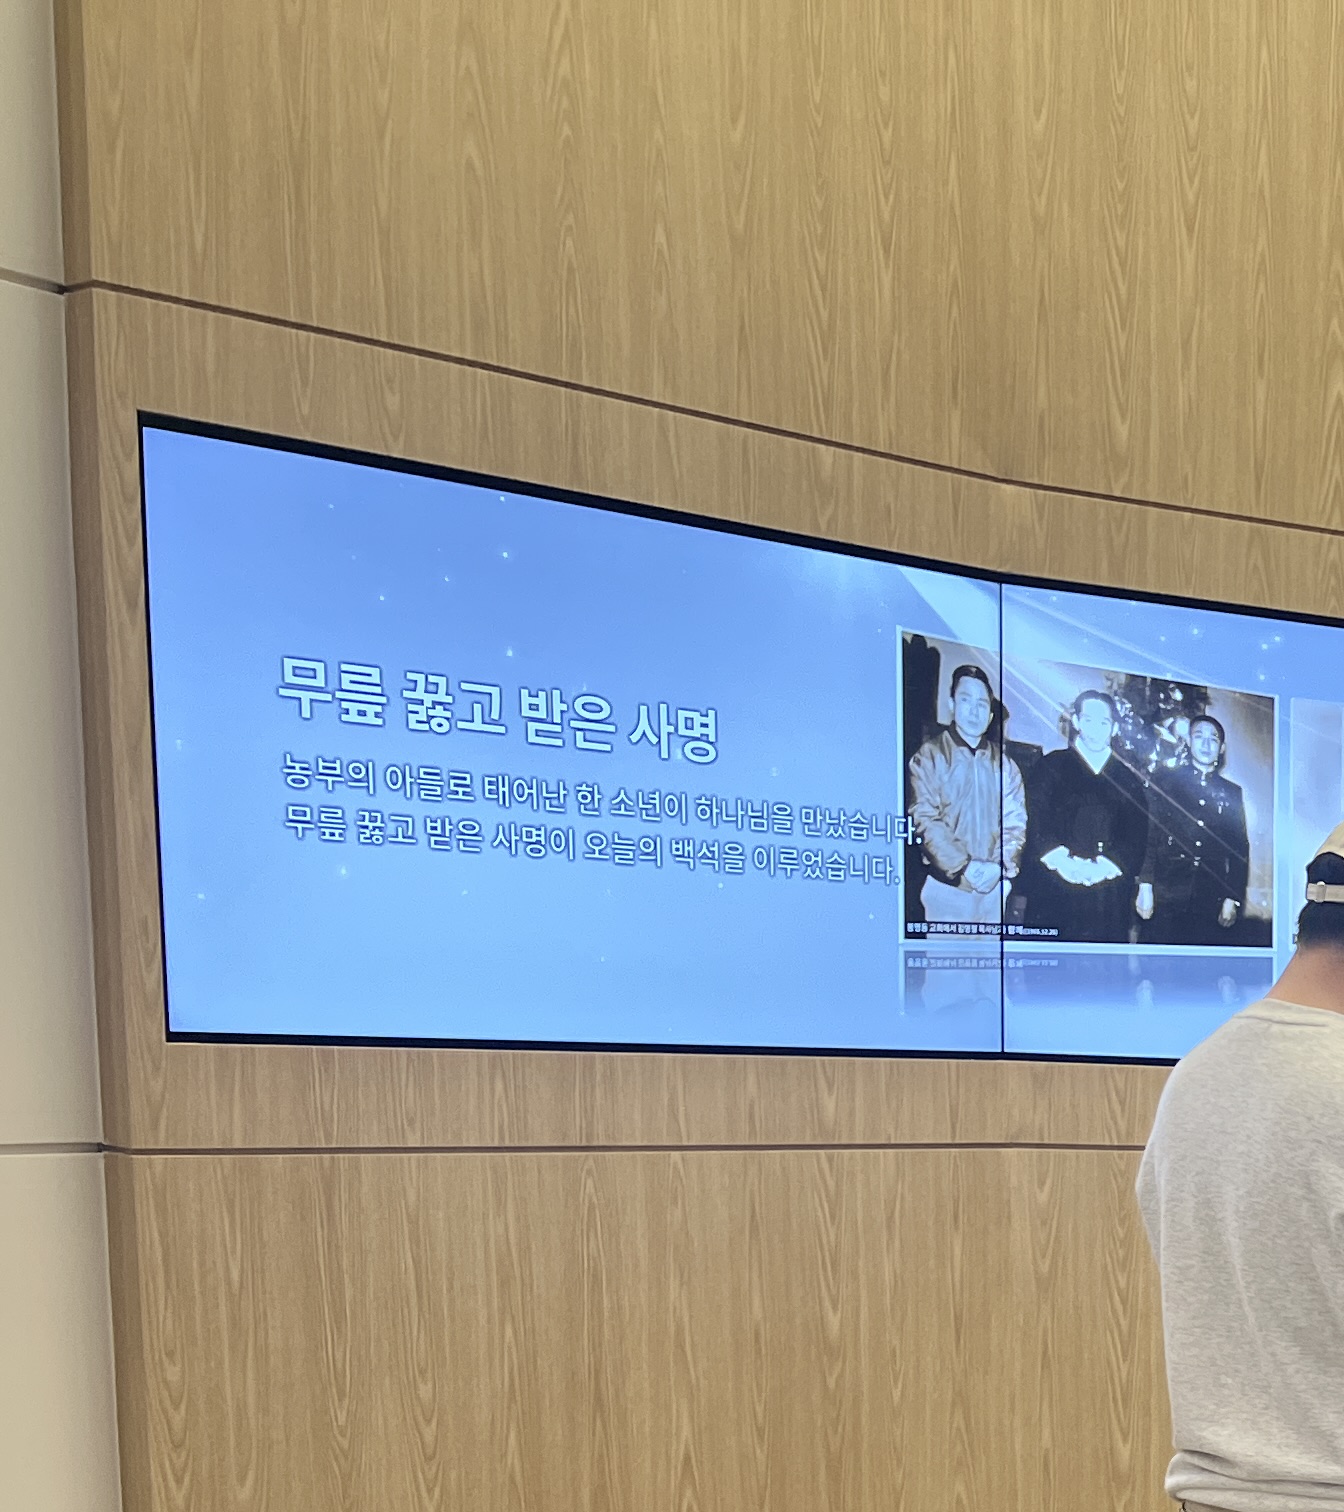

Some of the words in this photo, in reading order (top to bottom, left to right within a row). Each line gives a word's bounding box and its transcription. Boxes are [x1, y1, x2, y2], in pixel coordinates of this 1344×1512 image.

[277, 656, 388, 727] 무릎
[402, 670, 507, 735] 꿇고
[518, 687, 617, 752] 받은
[628, 702, 719, 764] 사명
[282, 753, 375, 796] 농부의
[384, 763, 476, 801] 아들로
[483, 773, 568, 813] 태어난
[575, 782, 603, 817] 한
[610, 788, 688, 826] 소년이
[695, 795, 795, 835] 하나님을
[800, 806, 923, 846] 만났습니다.
[285, 804, 347, 842] 무릎
[356, 810, 417, 846] 꿇고
[425, 816, 484, 853] 받은
[491, 821, 576, 861] 사명이
[583, 831, 663, 868] 오늘의
[670, 837, 746, 874] 백석을
[752, 845, 902, 886] 이루었습니다.
